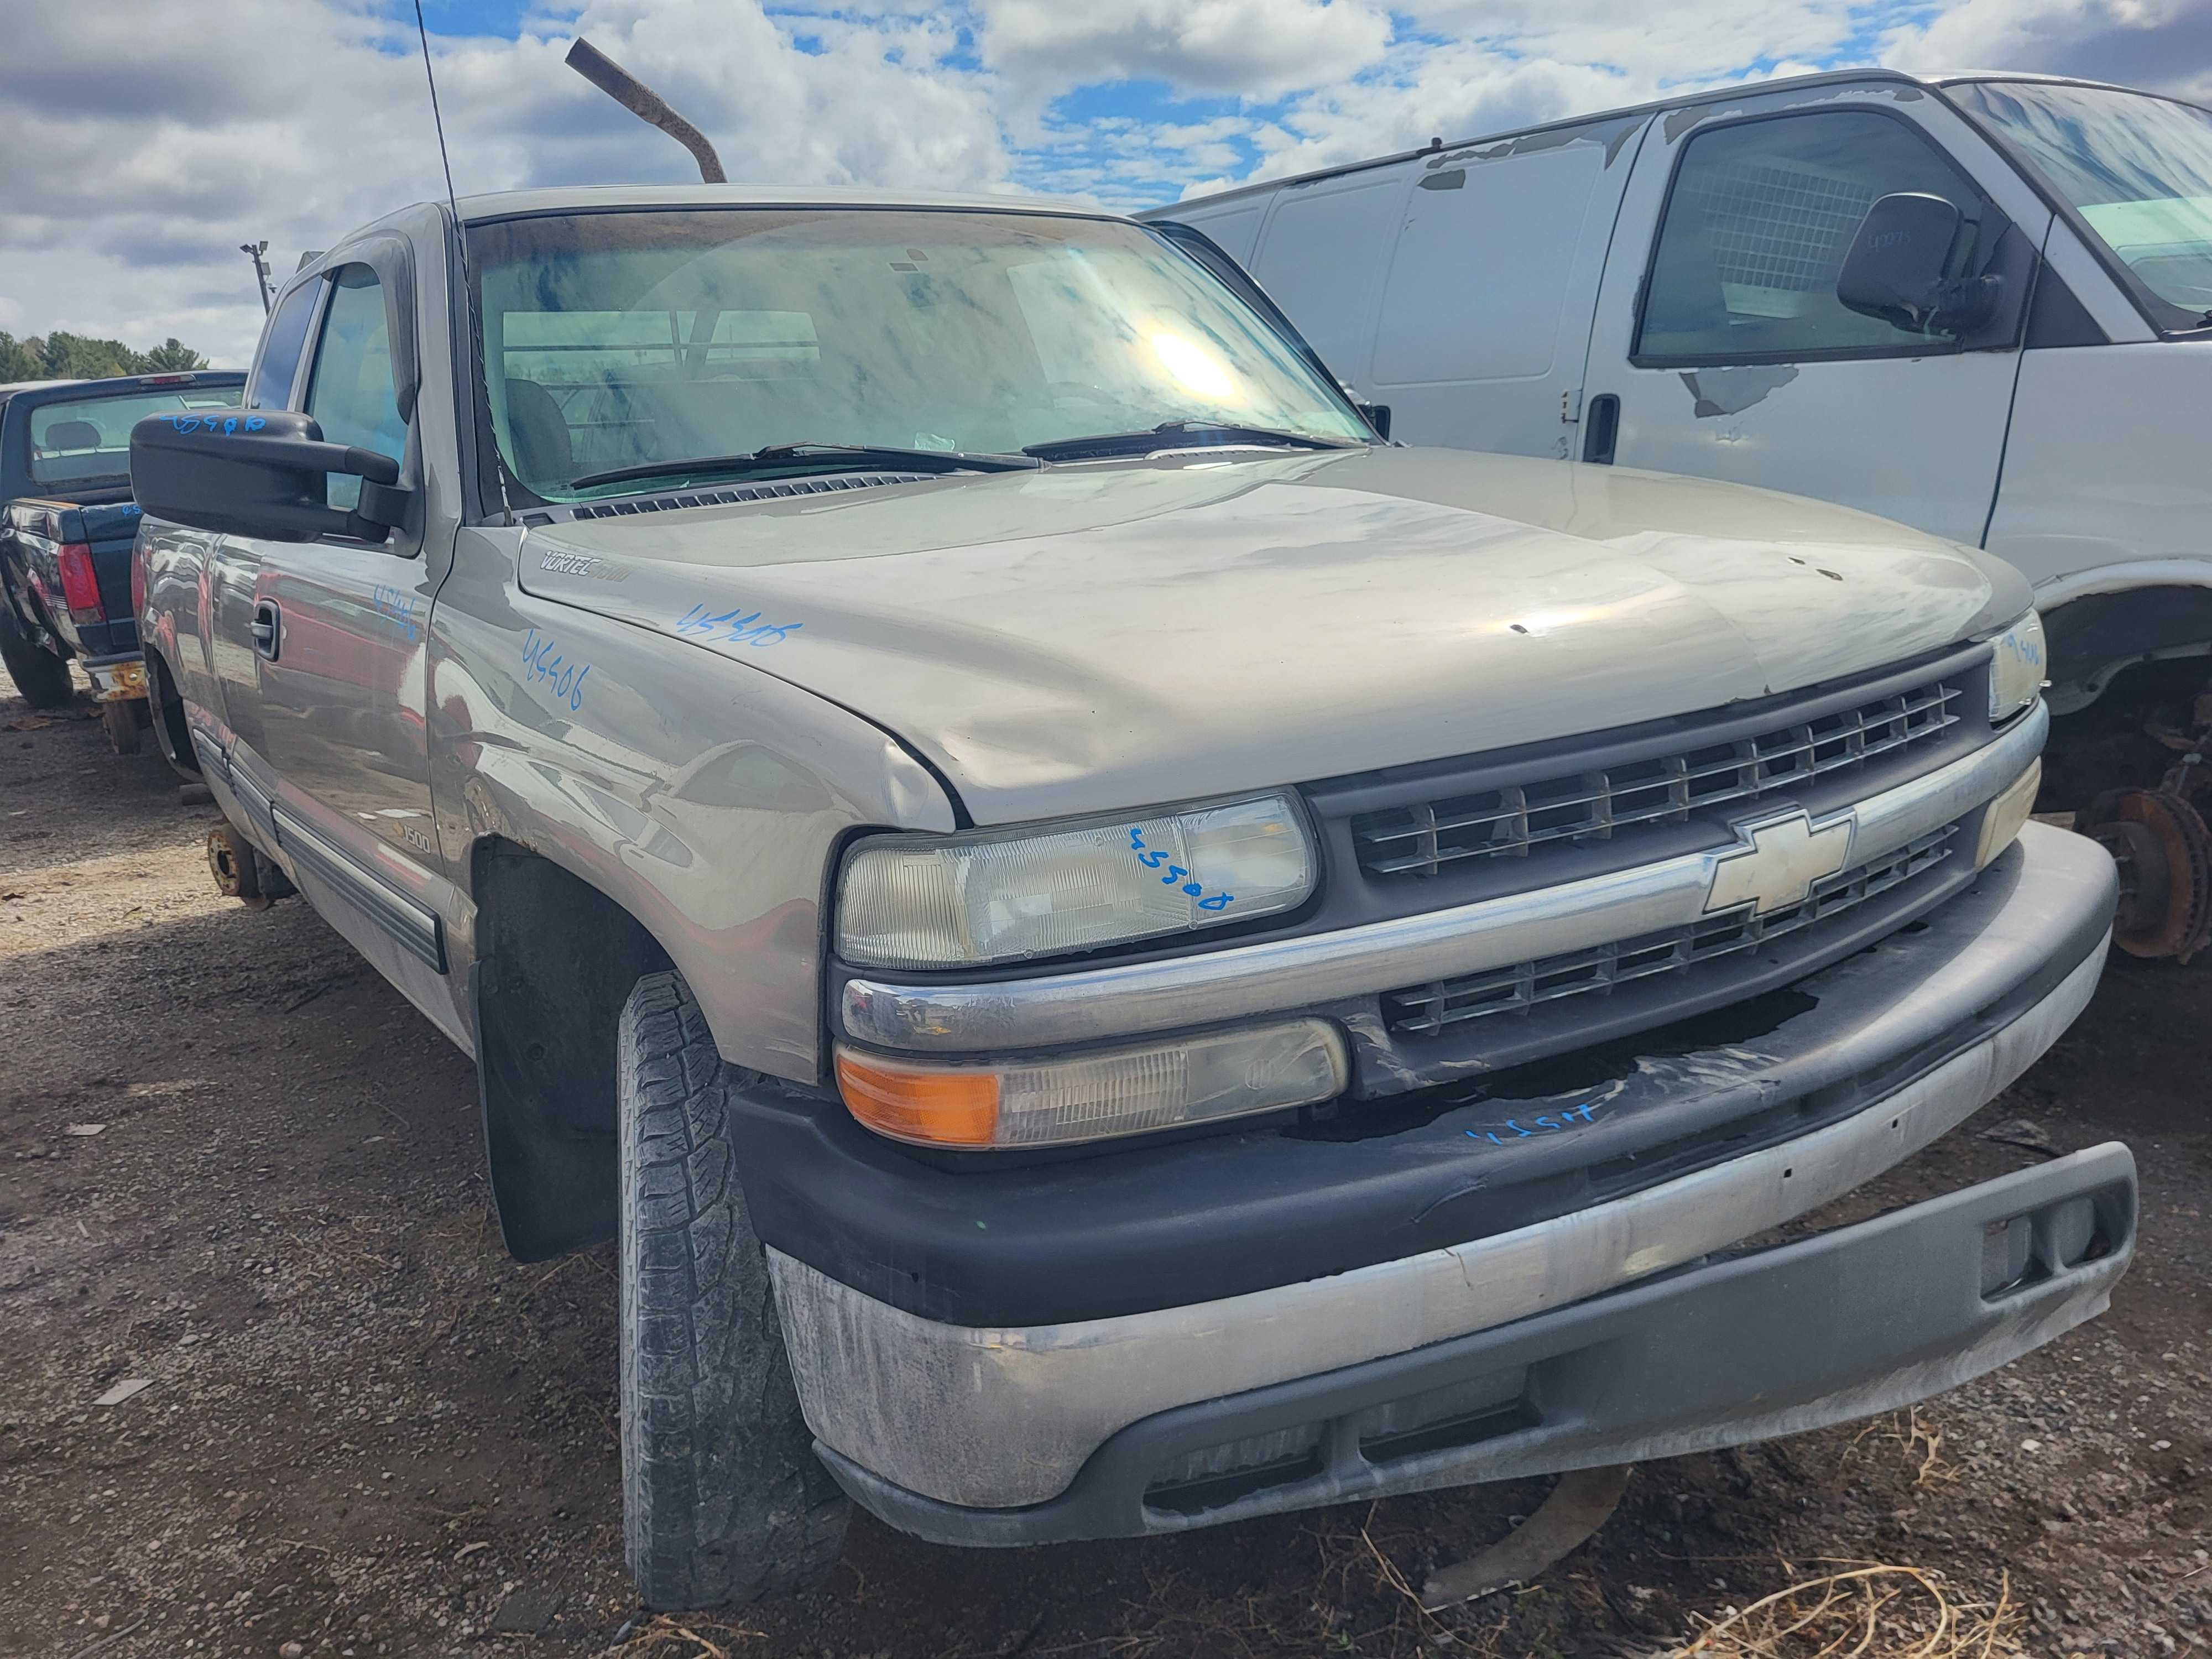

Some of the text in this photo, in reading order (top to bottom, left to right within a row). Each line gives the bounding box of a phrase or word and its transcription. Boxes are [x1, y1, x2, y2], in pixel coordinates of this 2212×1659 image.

[540, 550, 602, 576] VORTEC
[523, 628, 591, 711] 45506
[403, 824, 431, 854] 1500
